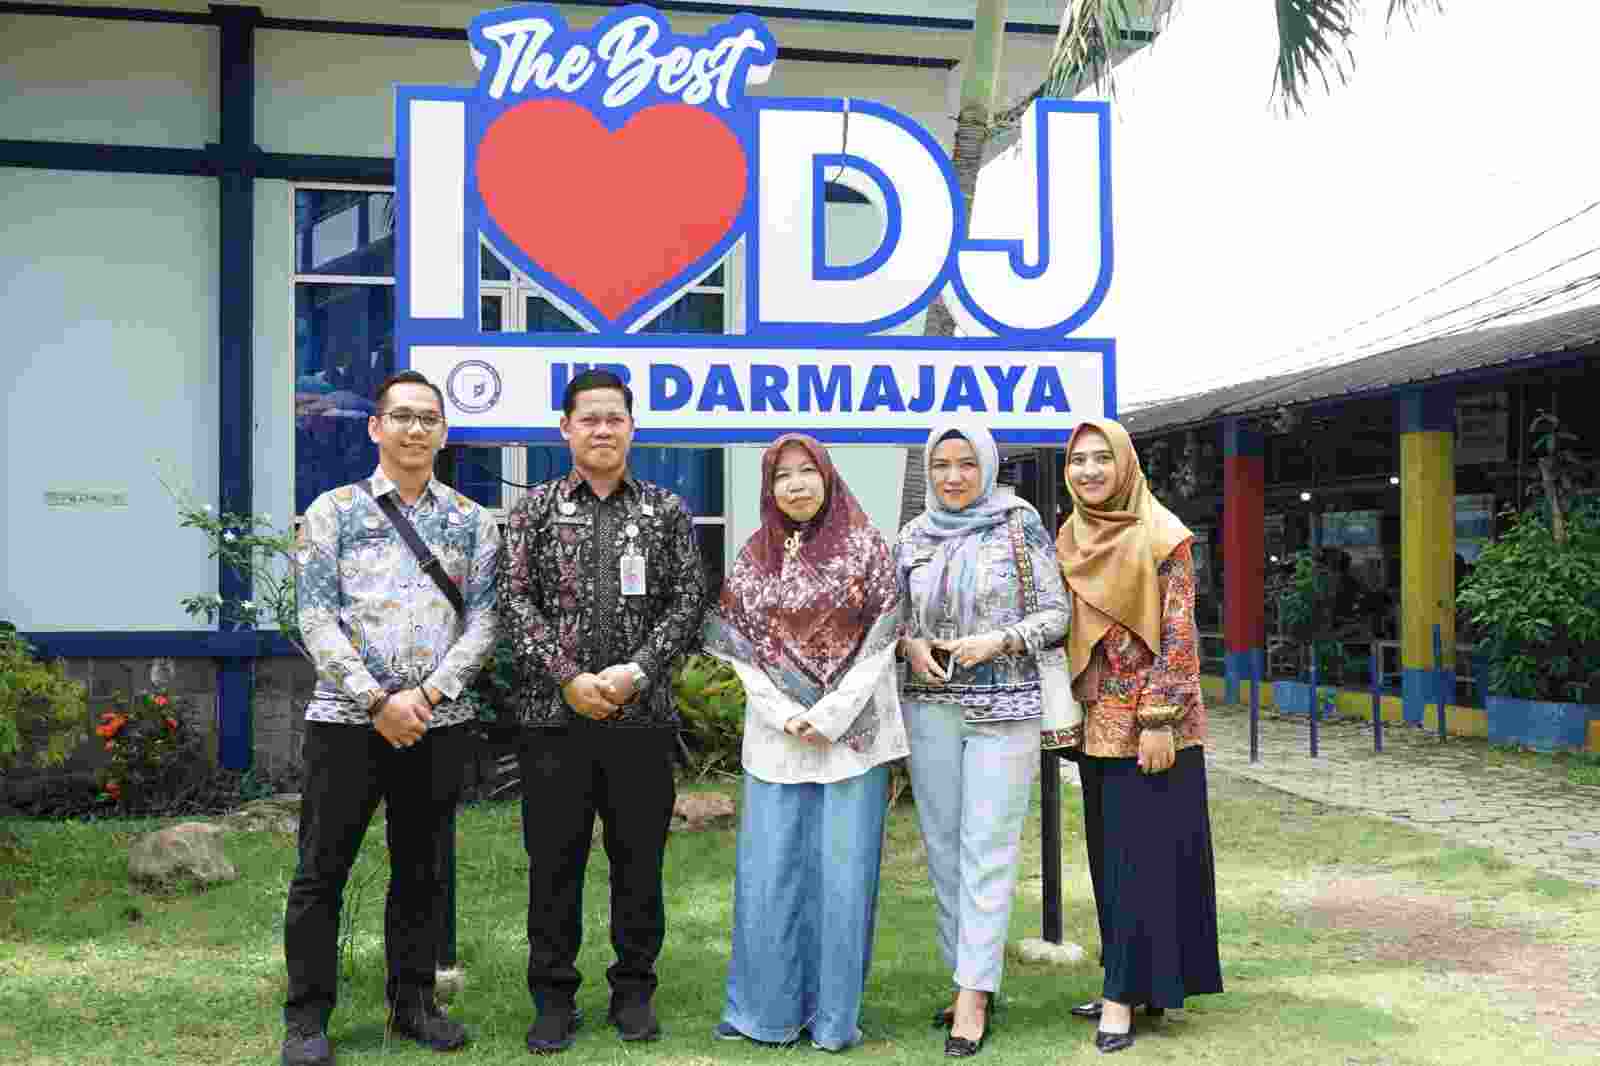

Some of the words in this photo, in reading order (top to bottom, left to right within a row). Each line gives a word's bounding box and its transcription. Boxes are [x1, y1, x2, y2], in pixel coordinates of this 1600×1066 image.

[482, 18, 596, 99] The
[597, 16, 766, 109] Best
[408, 99, 465, 320] I
[758, 108, 1104, 329] DJ
[648, 362, 1072, 413] DARMAJAYA
